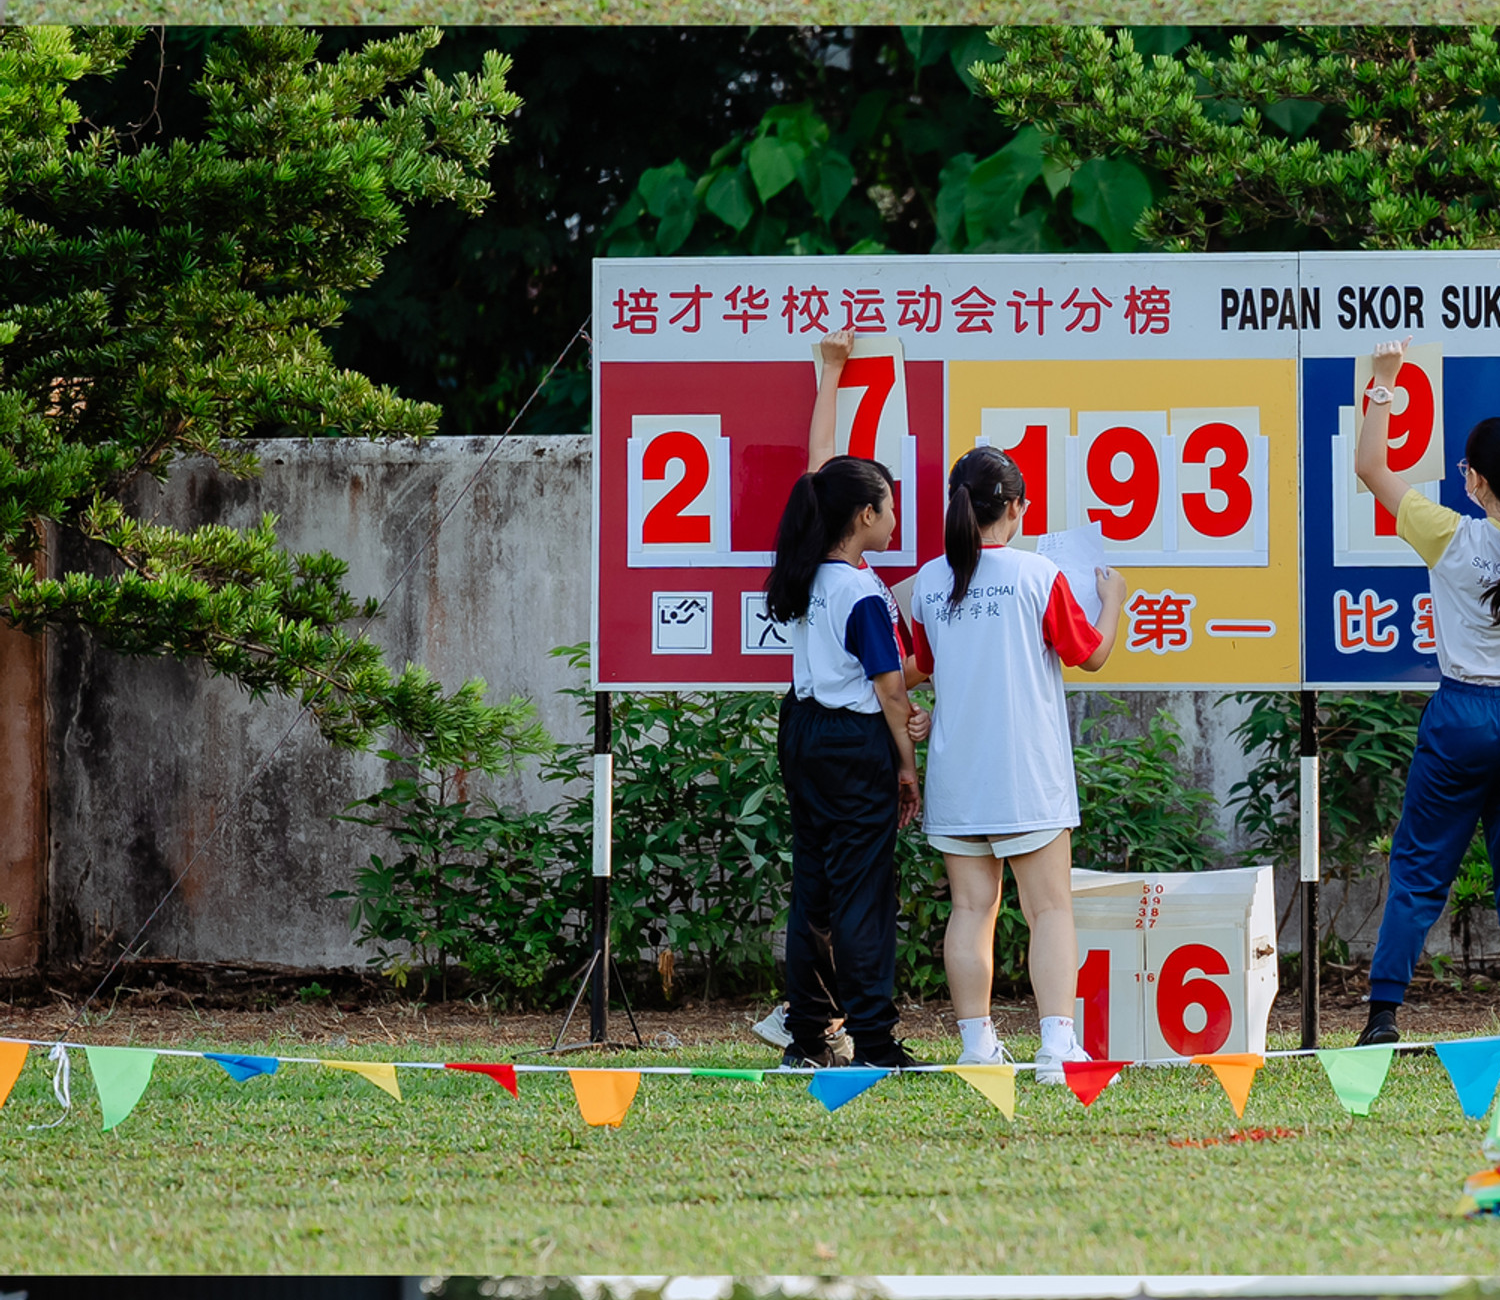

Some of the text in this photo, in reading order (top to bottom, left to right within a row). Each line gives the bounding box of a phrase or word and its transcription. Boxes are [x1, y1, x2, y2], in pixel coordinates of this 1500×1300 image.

[612, 283, 1173, 336] 培才华校运动会计分榜
[1220, 287, 1322, 331] PAPAN
[1338, 284, 1426, 330] SKOR
[836, 355, 896, 460] 7
[1362, 361, 1435, 474] 9
[641, 429, 712, 545] 2
[1002, 421, 1254, 542] 193
[925, 591, 944, 605] SJK
[986, 585, 1015, 598] CHAI
[1128, 592, 1275, 651] 第一
[1076, 943, 1233, 1061] 16
